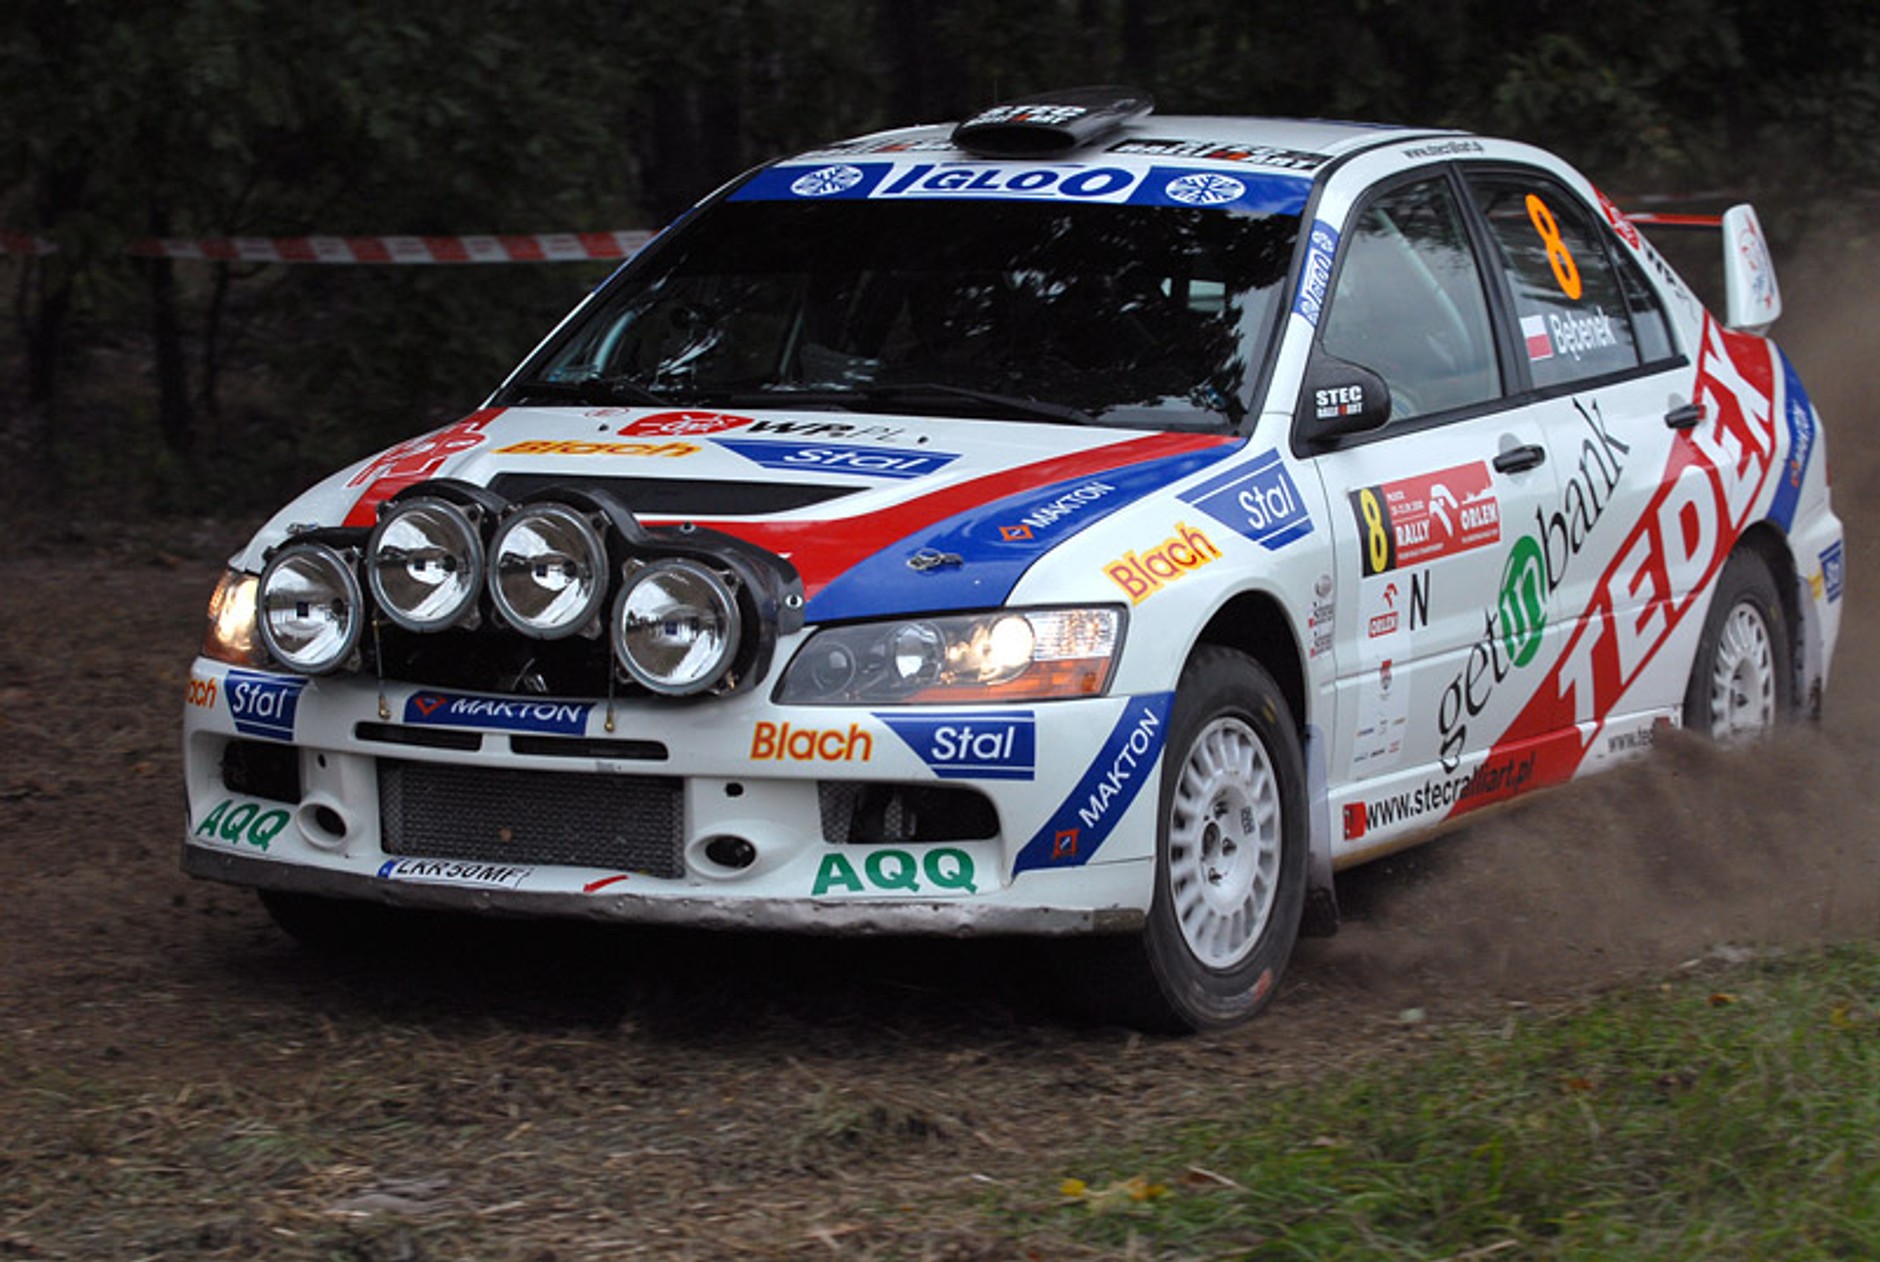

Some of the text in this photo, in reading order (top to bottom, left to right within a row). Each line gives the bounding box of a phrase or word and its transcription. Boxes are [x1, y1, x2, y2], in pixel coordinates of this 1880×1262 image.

[881, 163, 1136, 198] IGLOO
[1525, 193, 1583, 300] 8
[1316, 385, 1362, 407] STEC
[784, 449, 929, 470] Stal
[1021, 481, 1116, 529] MAKTON
[1239, 474, 1297, 531] Stal
[1460, 502, 1498, 532] ORLEN
[1360, 488, 1389, 573] 8
[1396, 519, 1430, 547] RALLY
[1557, 321, 1772, 748] TEDEX
[1105, 524, 1221, 604] Blach
[1409, 568, 1430, 631] N
[232, 681, 289, 719] Stal
[450, 698, 583, 724] MAKTON
[750, 721, 873, 762] Blach
[930, 726, 1016, 760] Stal
[1077, 707, 1162, 829] MAKTON
[194, 799, 291, 852] AQQ
[811, 847, 979, 897] AQQ
